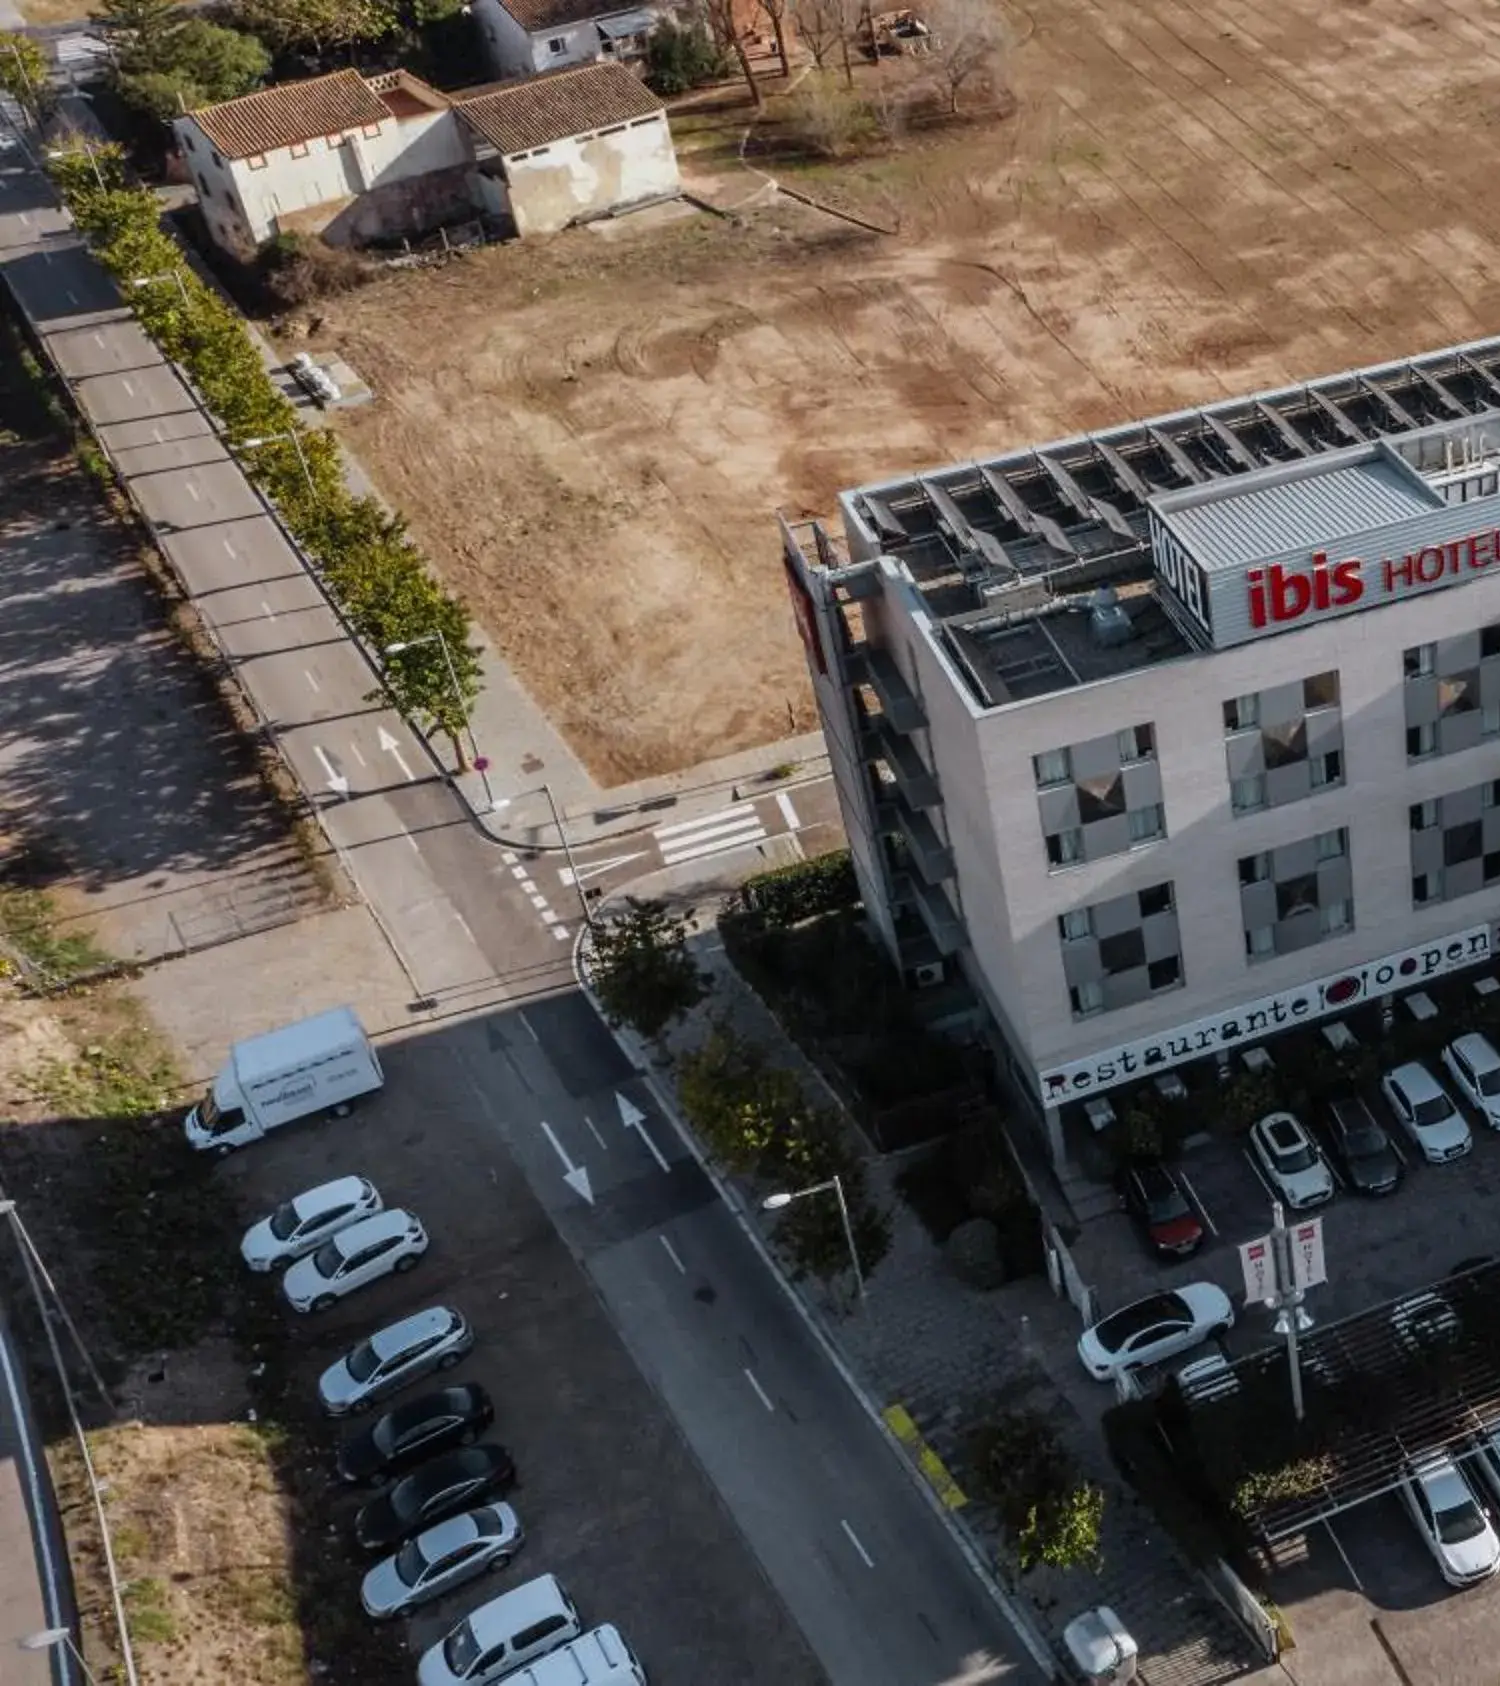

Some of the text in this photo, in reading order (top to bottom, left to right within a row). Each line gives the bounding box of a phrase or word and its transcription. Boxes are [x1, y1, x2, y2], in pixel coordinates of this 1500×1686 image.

[1147, 509, 1209, 632] HOTEL
[1247, 548, 1365, 629] ibis
[1043, 995, 1310, 1100] Restaurante
